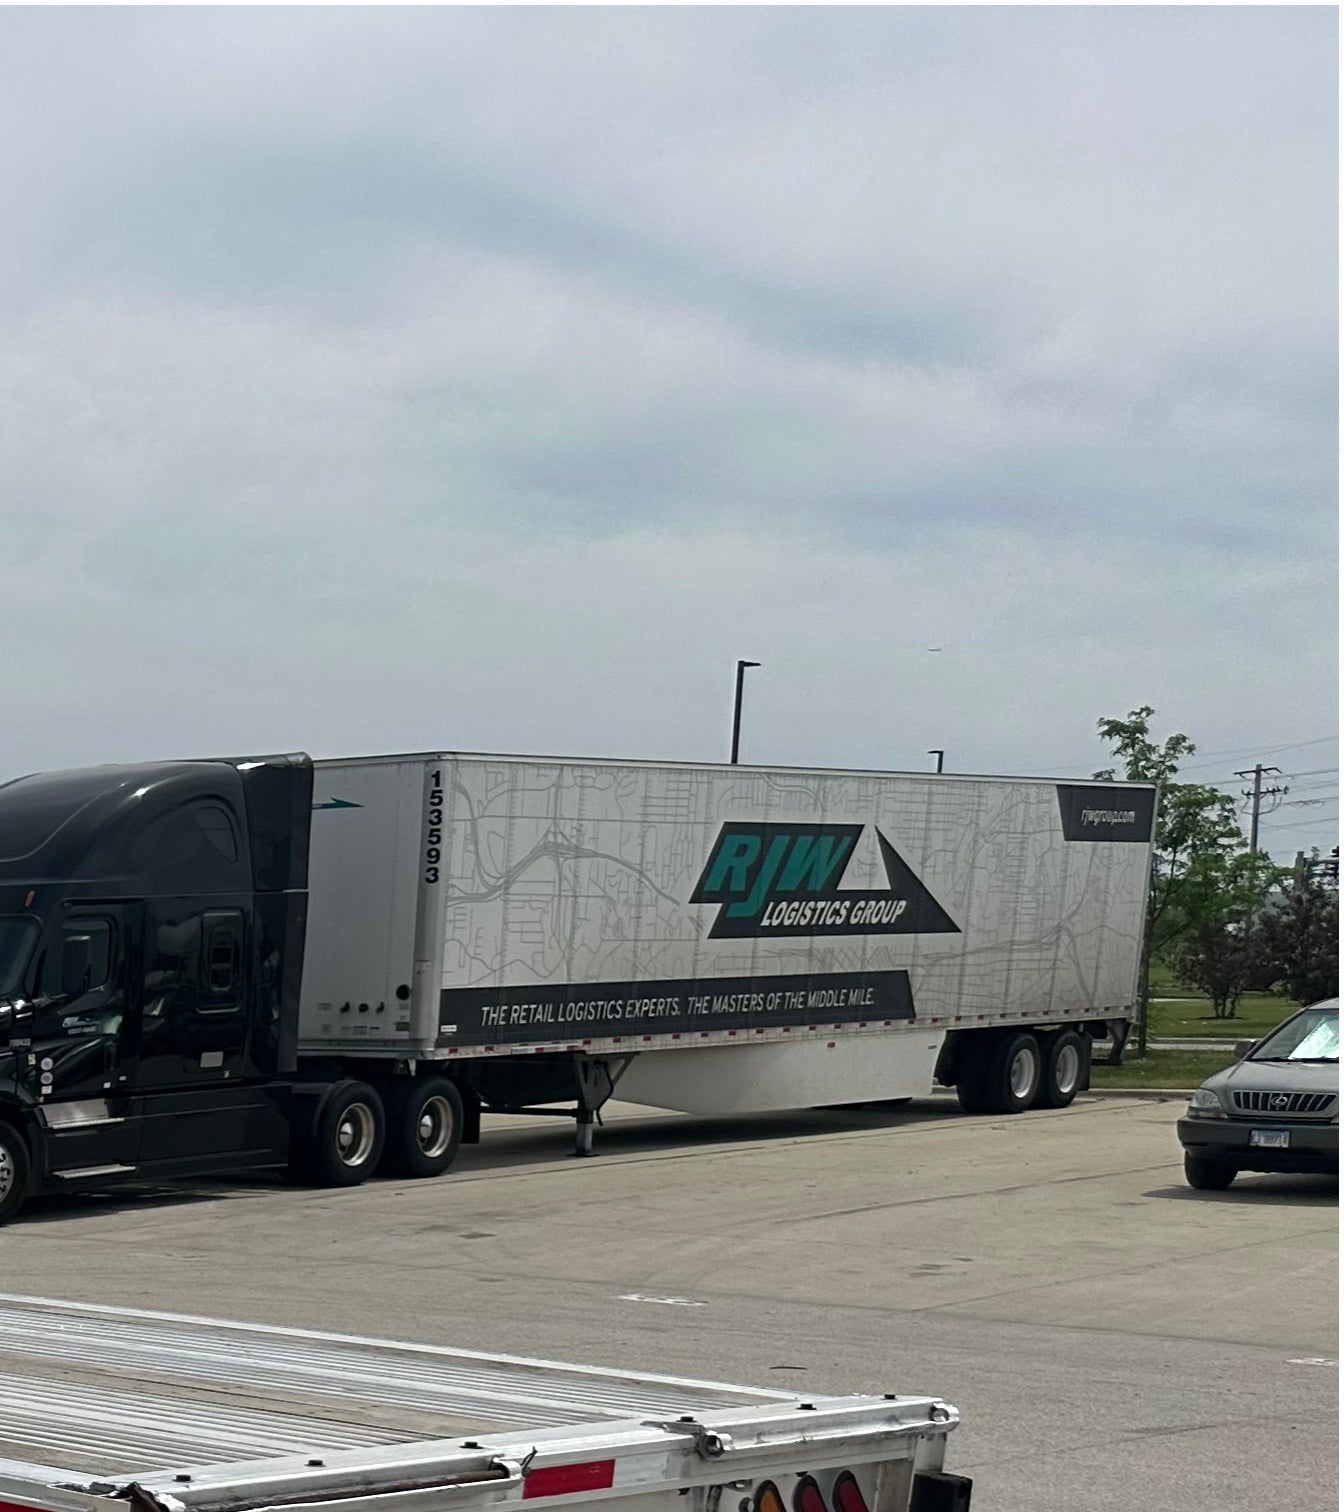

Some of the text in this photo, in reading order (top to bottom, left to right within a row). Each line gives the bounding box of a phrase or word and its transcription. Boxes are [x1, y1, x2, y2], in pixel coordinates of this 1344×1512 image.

[425, 770, 443, 884] 153593
[703, 834, 852, 918] RJW
[760, 900, 907, 927] LOGISTICS GROUP
[481, 1005, 508, 1026] THE
[510, 1003, 555, 1024] RETAIL
[557, 999, 623, 1022] LOGISTICS
[625, 997, 681, 1018] EXPERTS.
[688, 995, 710, 1015] THE
[712, 993, 765, 1013] MASTERS
[766, 991, 783, 1010] OF
[784, 990, 806, 1010] THE
[807, 988, 847, 1008] MIDDLE
